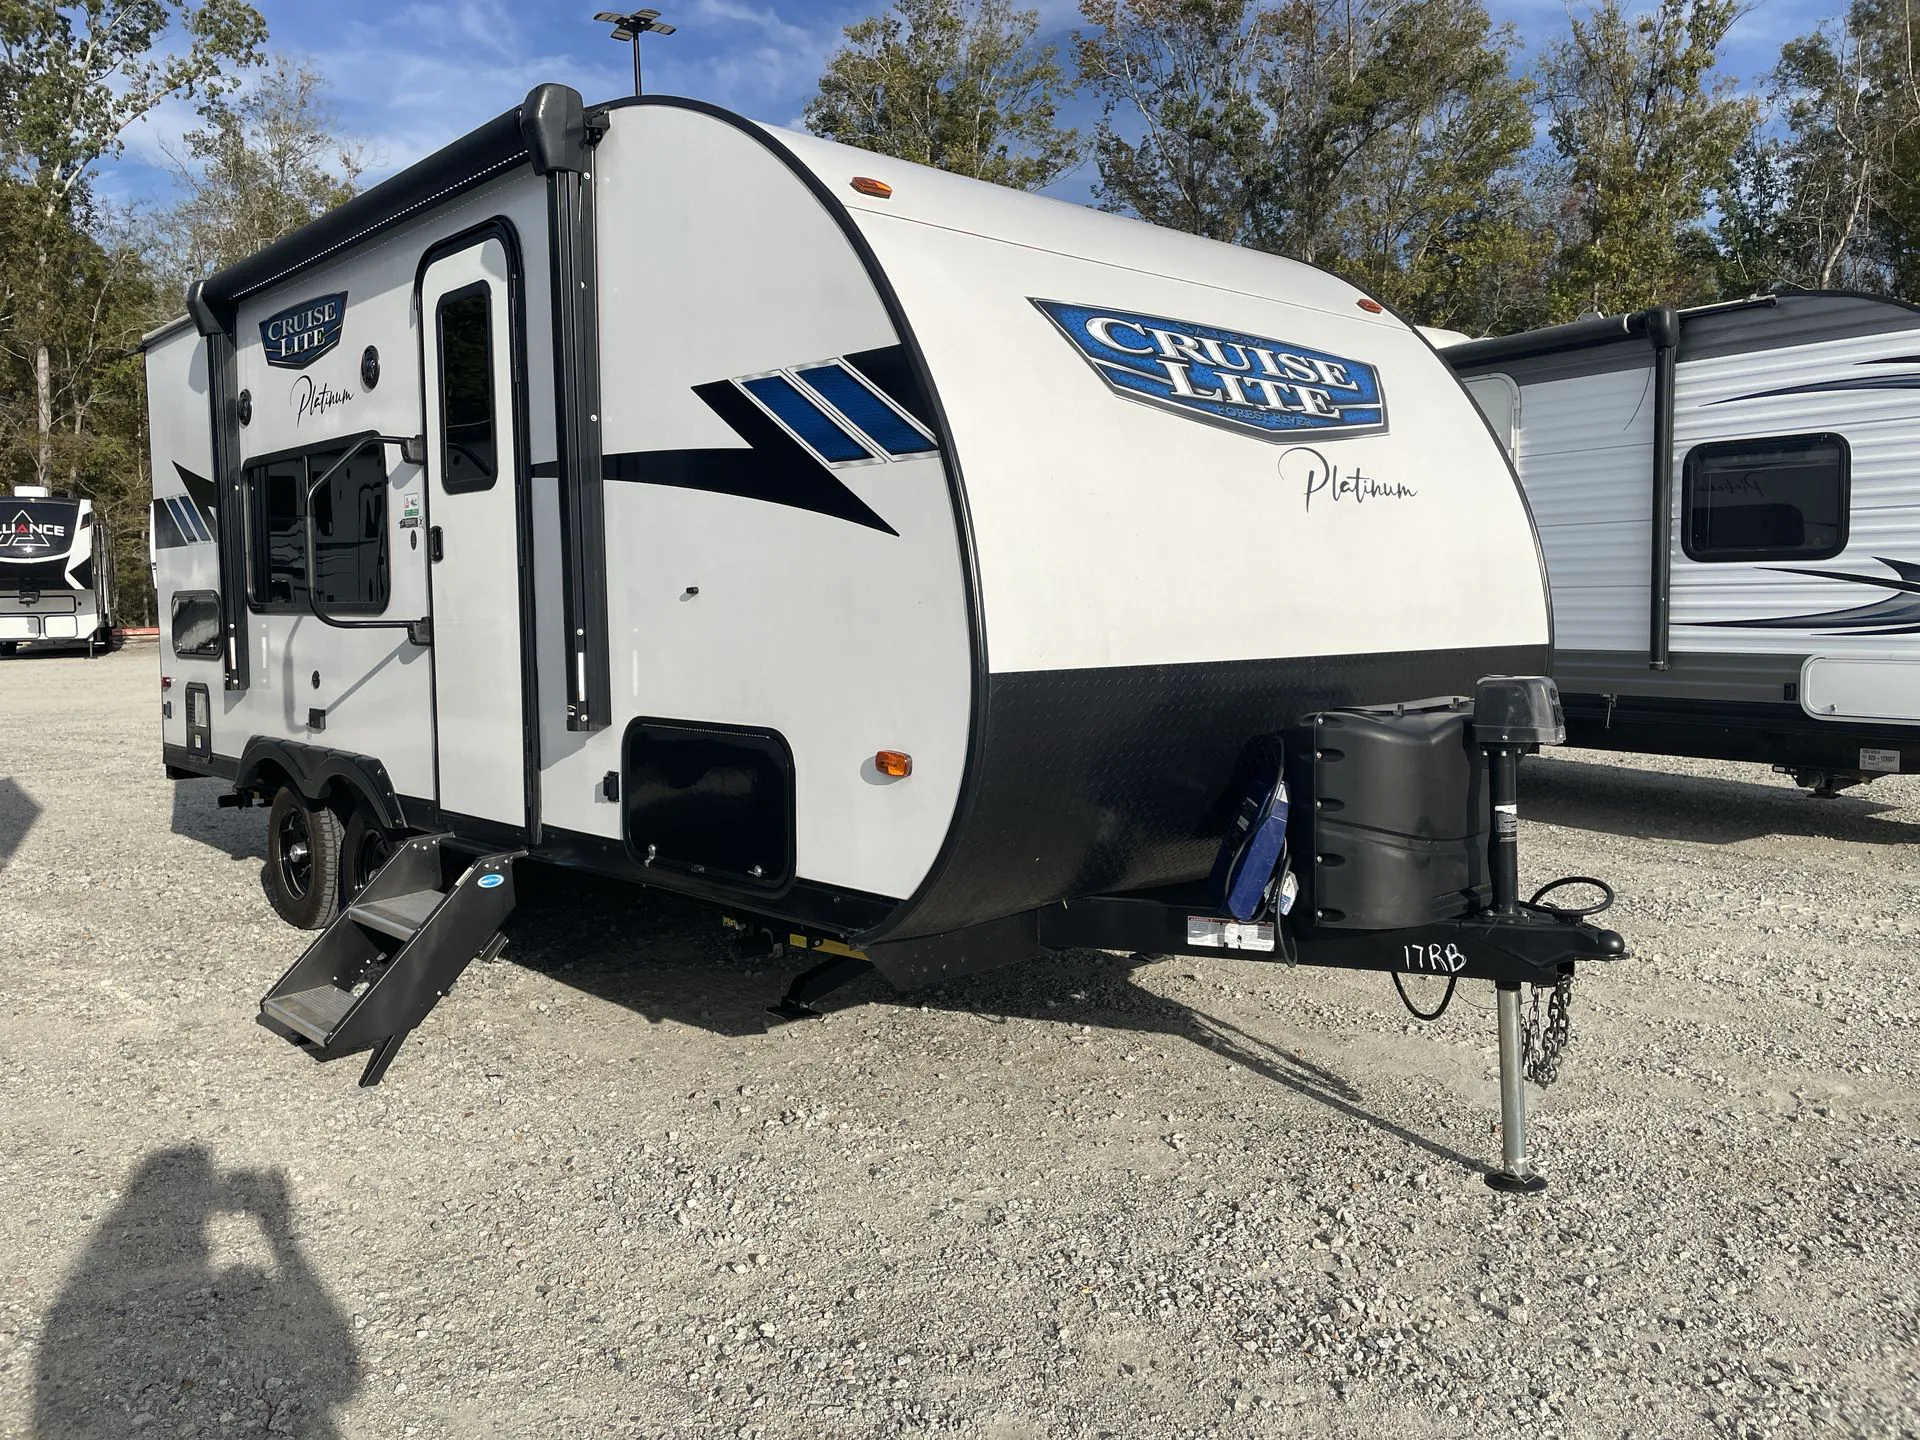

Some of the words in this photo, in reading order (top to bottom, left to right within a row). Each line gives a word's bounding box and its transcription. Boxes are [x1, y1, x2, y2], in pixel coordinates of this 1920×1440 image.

[267, 302, 336, 341] CRUISE
[279, 327, 326, 358] LITE
[1085, 316, 1358, 390] CRUISE
[289, 374, 355, 429] Platinum
[1155, 359, 1341, 419] LITE
[1216, 404, 1271, 421] FOREST
[1275, 412, 1314, 428] RIVER
[1277, 446, 1419, 513] Platinum
[0, 523, 65, 537] LIANCE
[1404, 942, 1468, 973] 17RB
